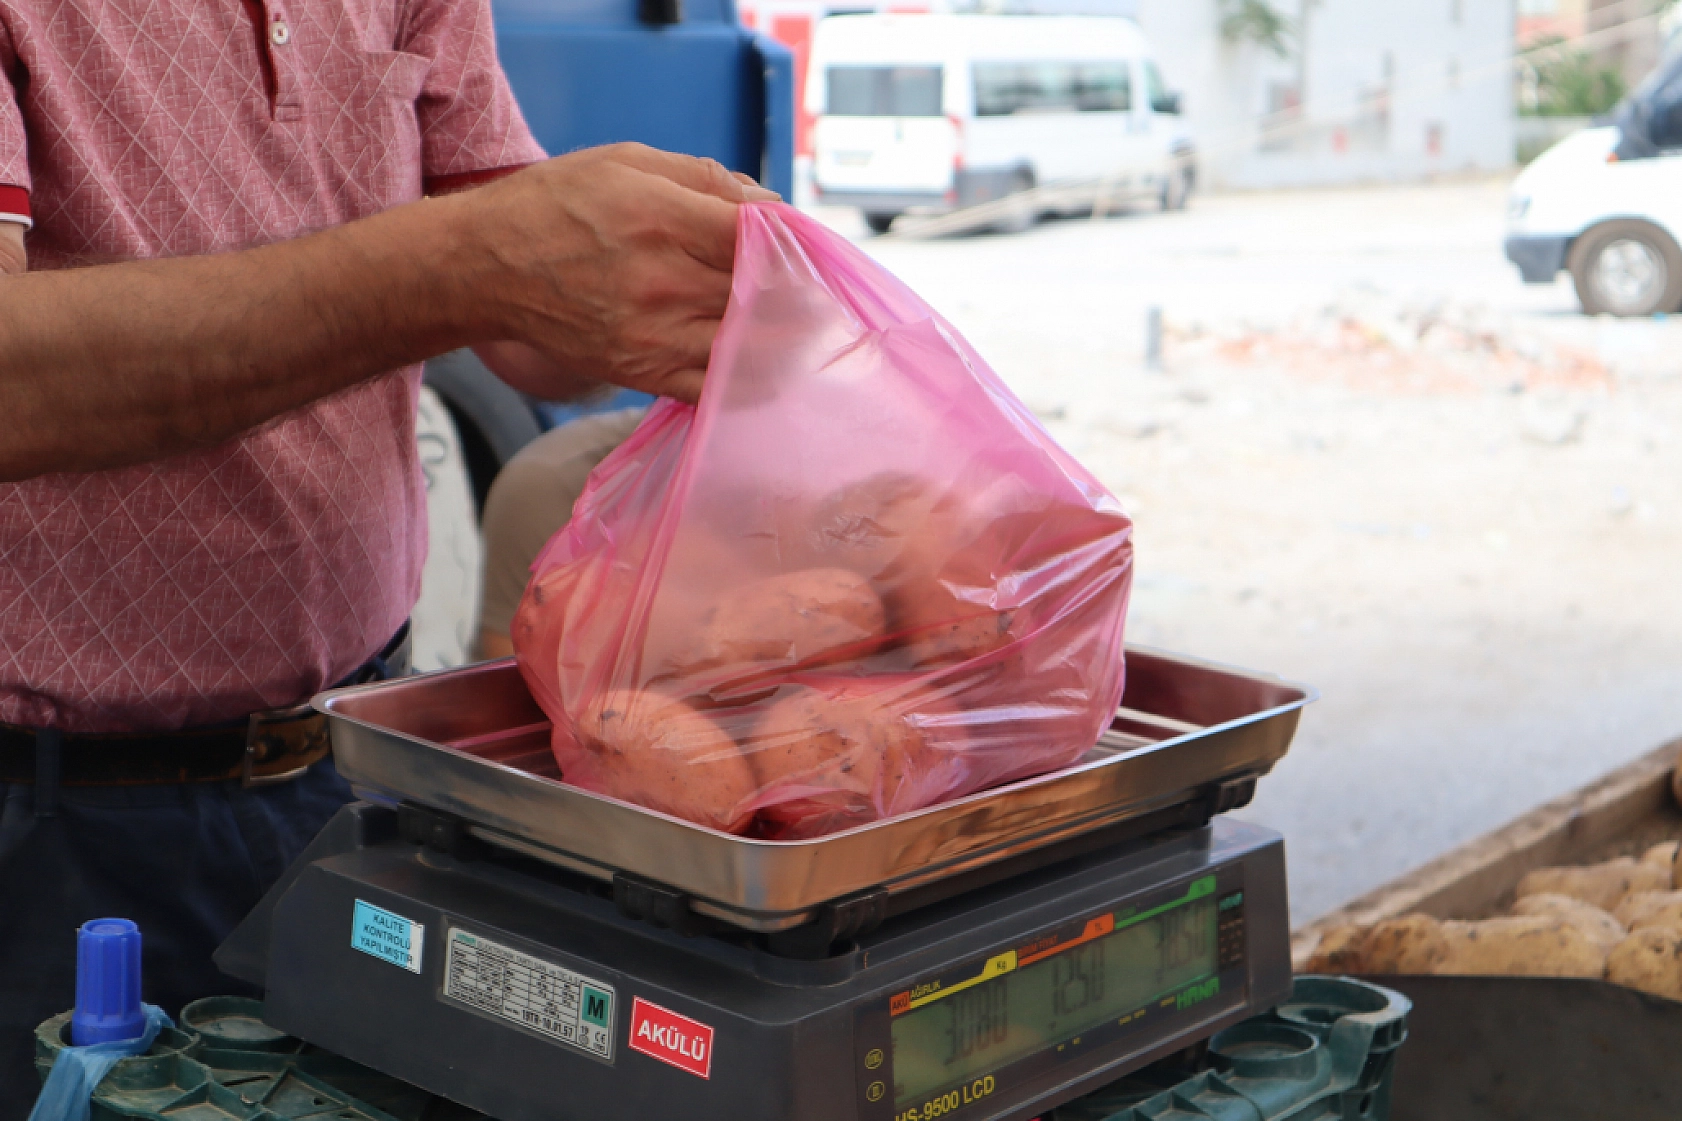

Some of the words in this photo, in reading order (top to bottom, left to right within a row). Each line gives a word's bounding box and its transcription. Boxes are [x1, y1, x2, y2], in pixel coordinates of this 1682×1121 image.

[588, 994, 605, 1020] M
[637, 1018, 706, 1062] AKÜLÜ
[962, 1074, 996, 1104] LCD
